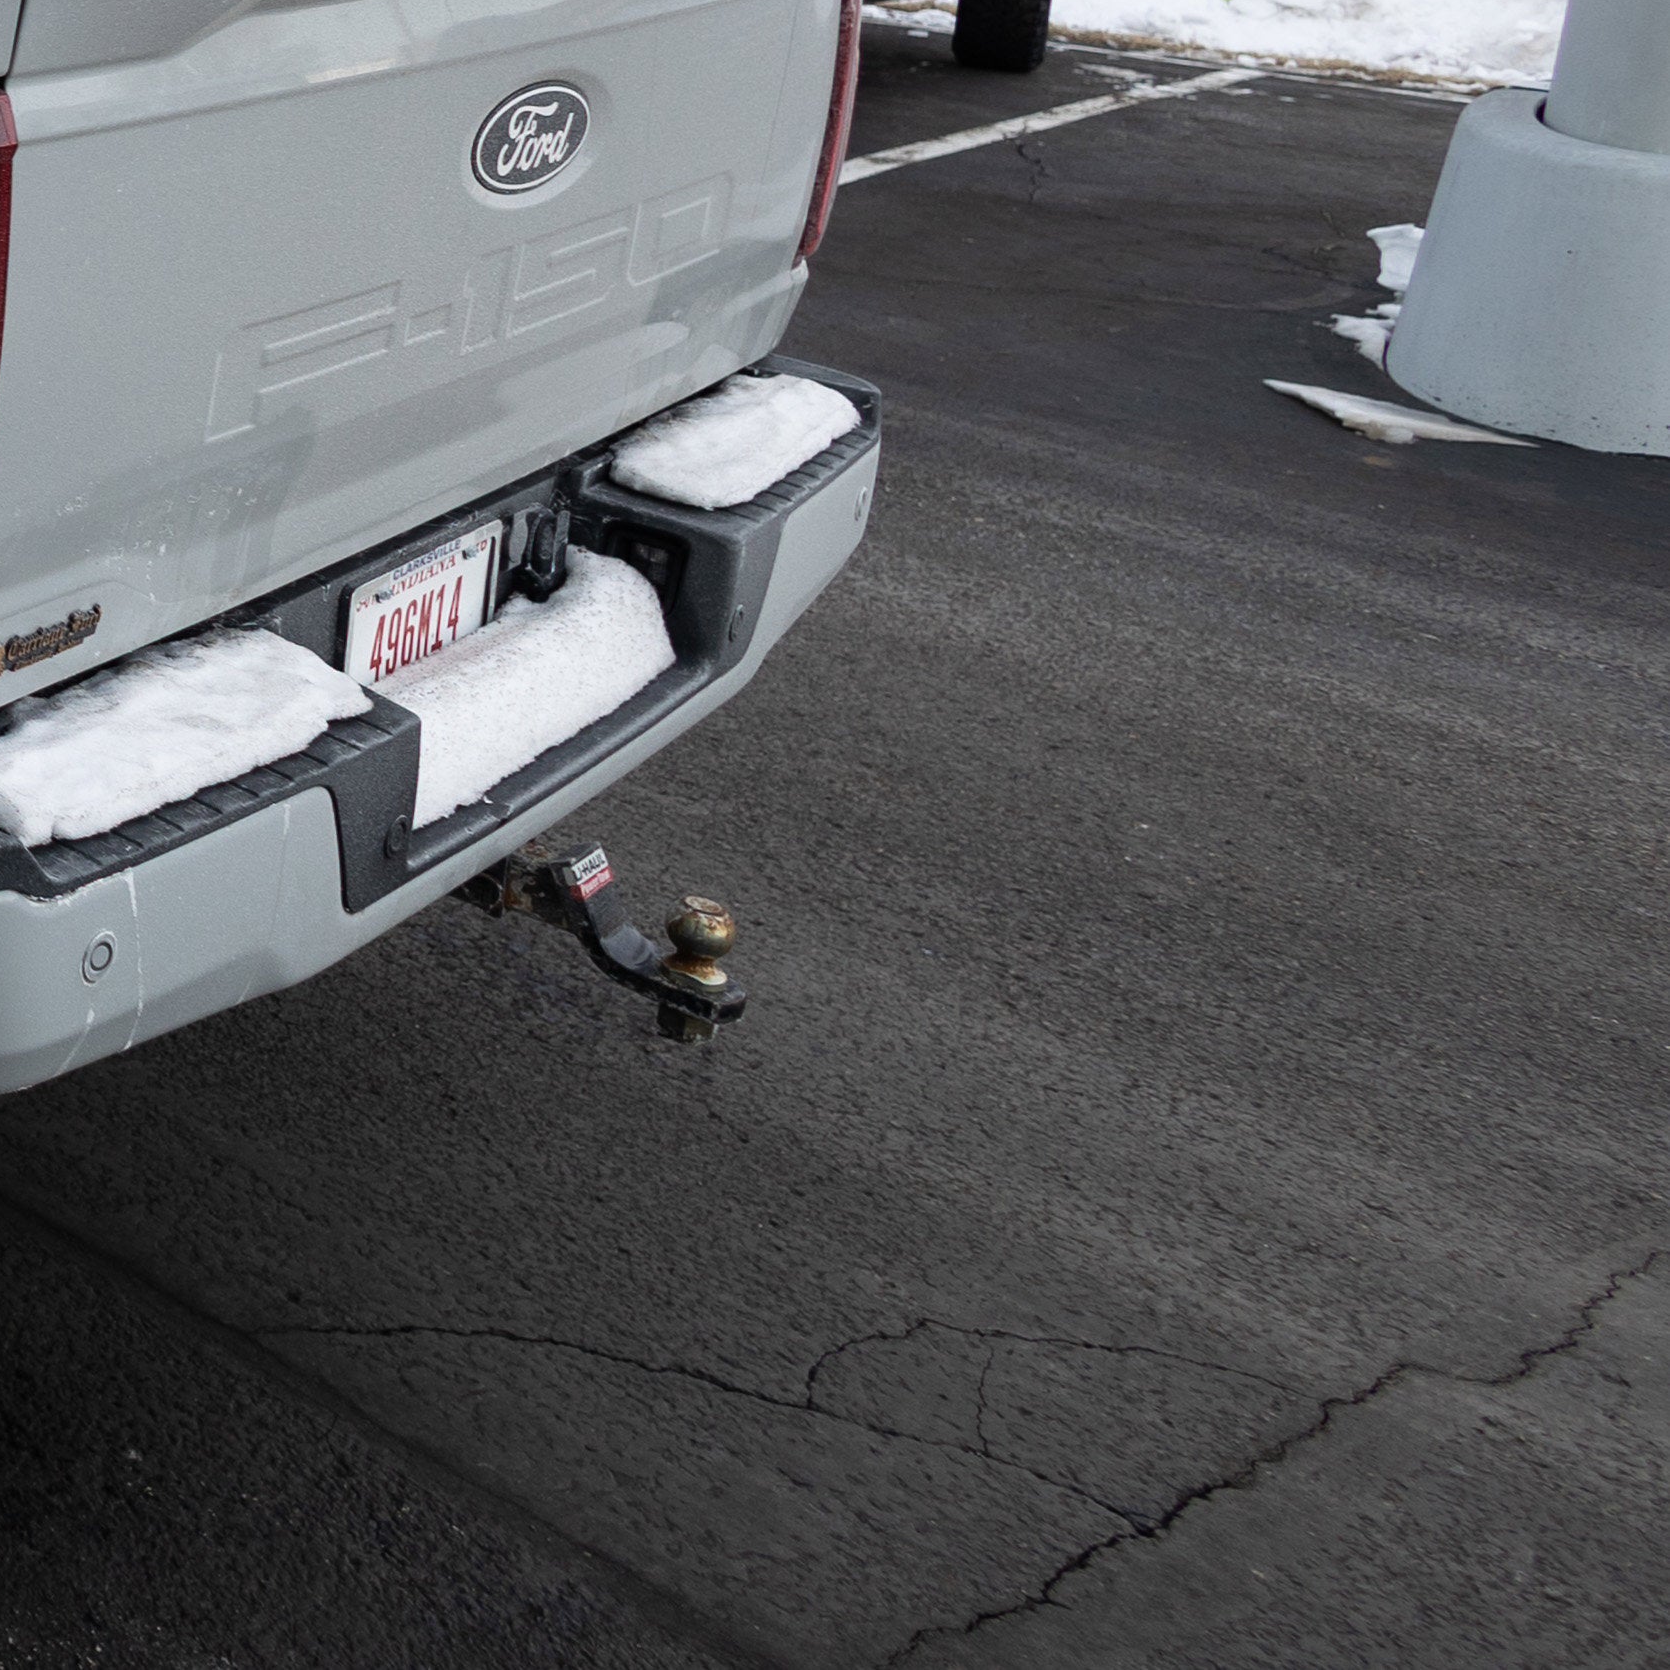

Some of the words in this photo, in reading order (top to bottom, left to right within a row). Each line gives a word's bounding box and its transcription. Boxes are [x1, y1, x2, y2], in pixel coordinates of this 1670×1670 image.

[496, 101, 574, 177] Ford
[205, 172, 735, 444] F-150
[391, 554, 457, 596] INDIANA
[392, 538, 462, 581] CLARKSVILLE
[369, 575, 463, 682] 496M14
